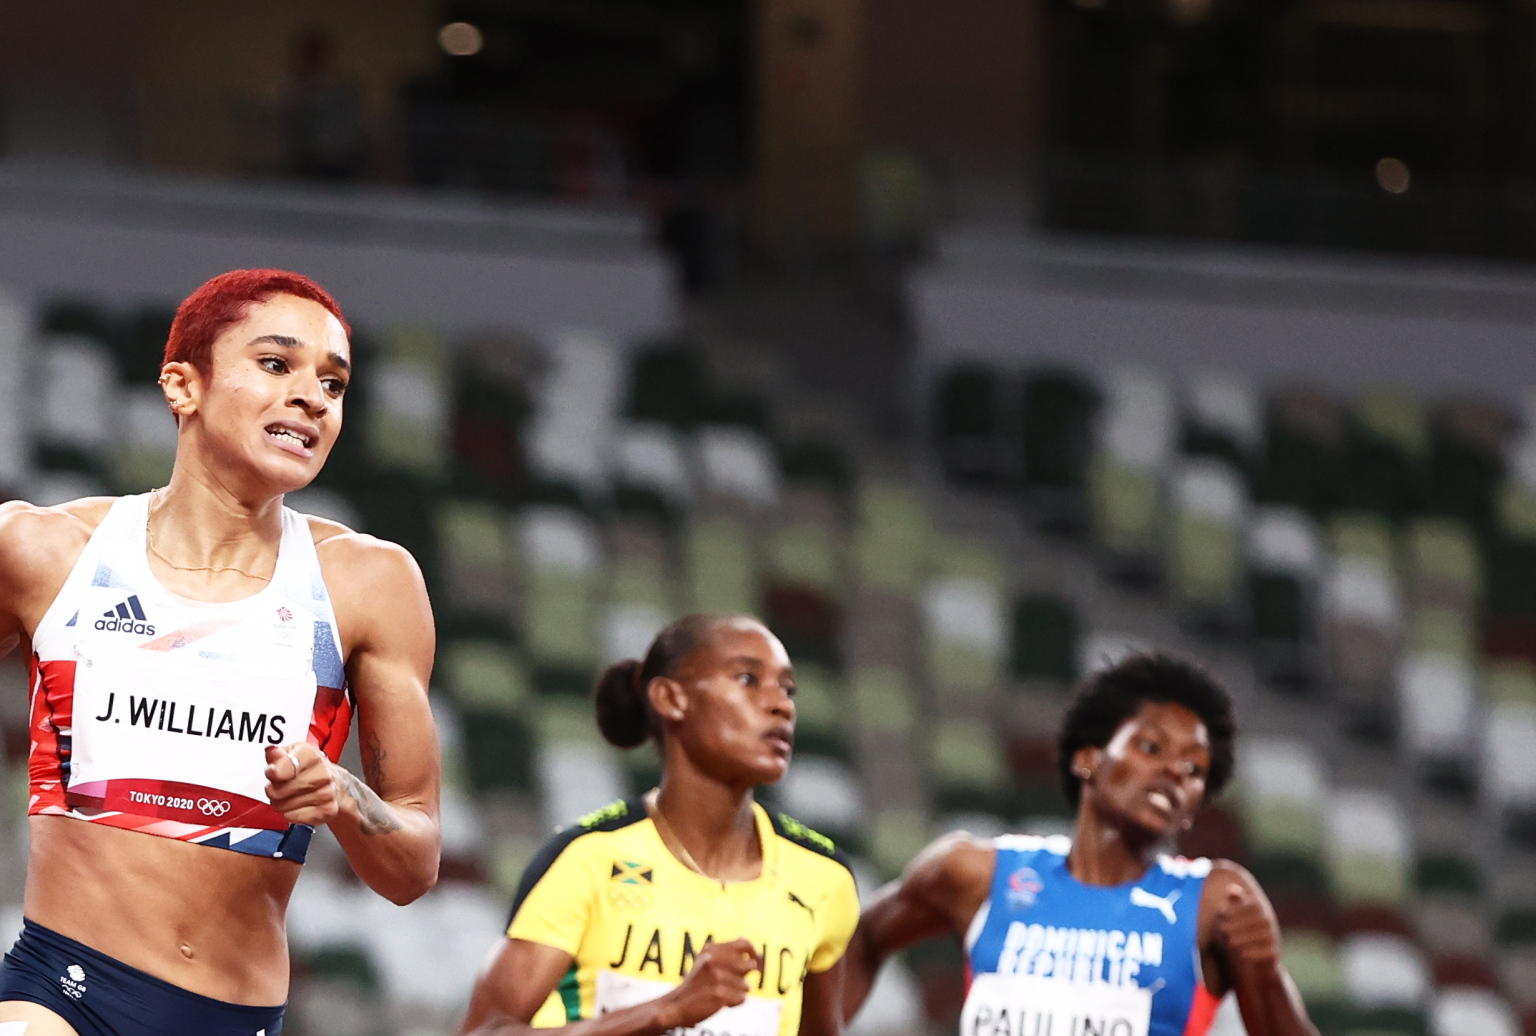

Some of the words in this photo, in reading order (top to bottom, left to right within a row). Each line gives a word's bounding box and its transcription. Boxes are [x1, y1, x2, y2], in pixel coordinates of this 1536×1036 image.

[94, 617, 156, 636] adidas
[129, 791, 165, 806] TOKYO
[166, 796, 194, 810] 2020
[1004, 920, 1163, 968] DOMINICAN
